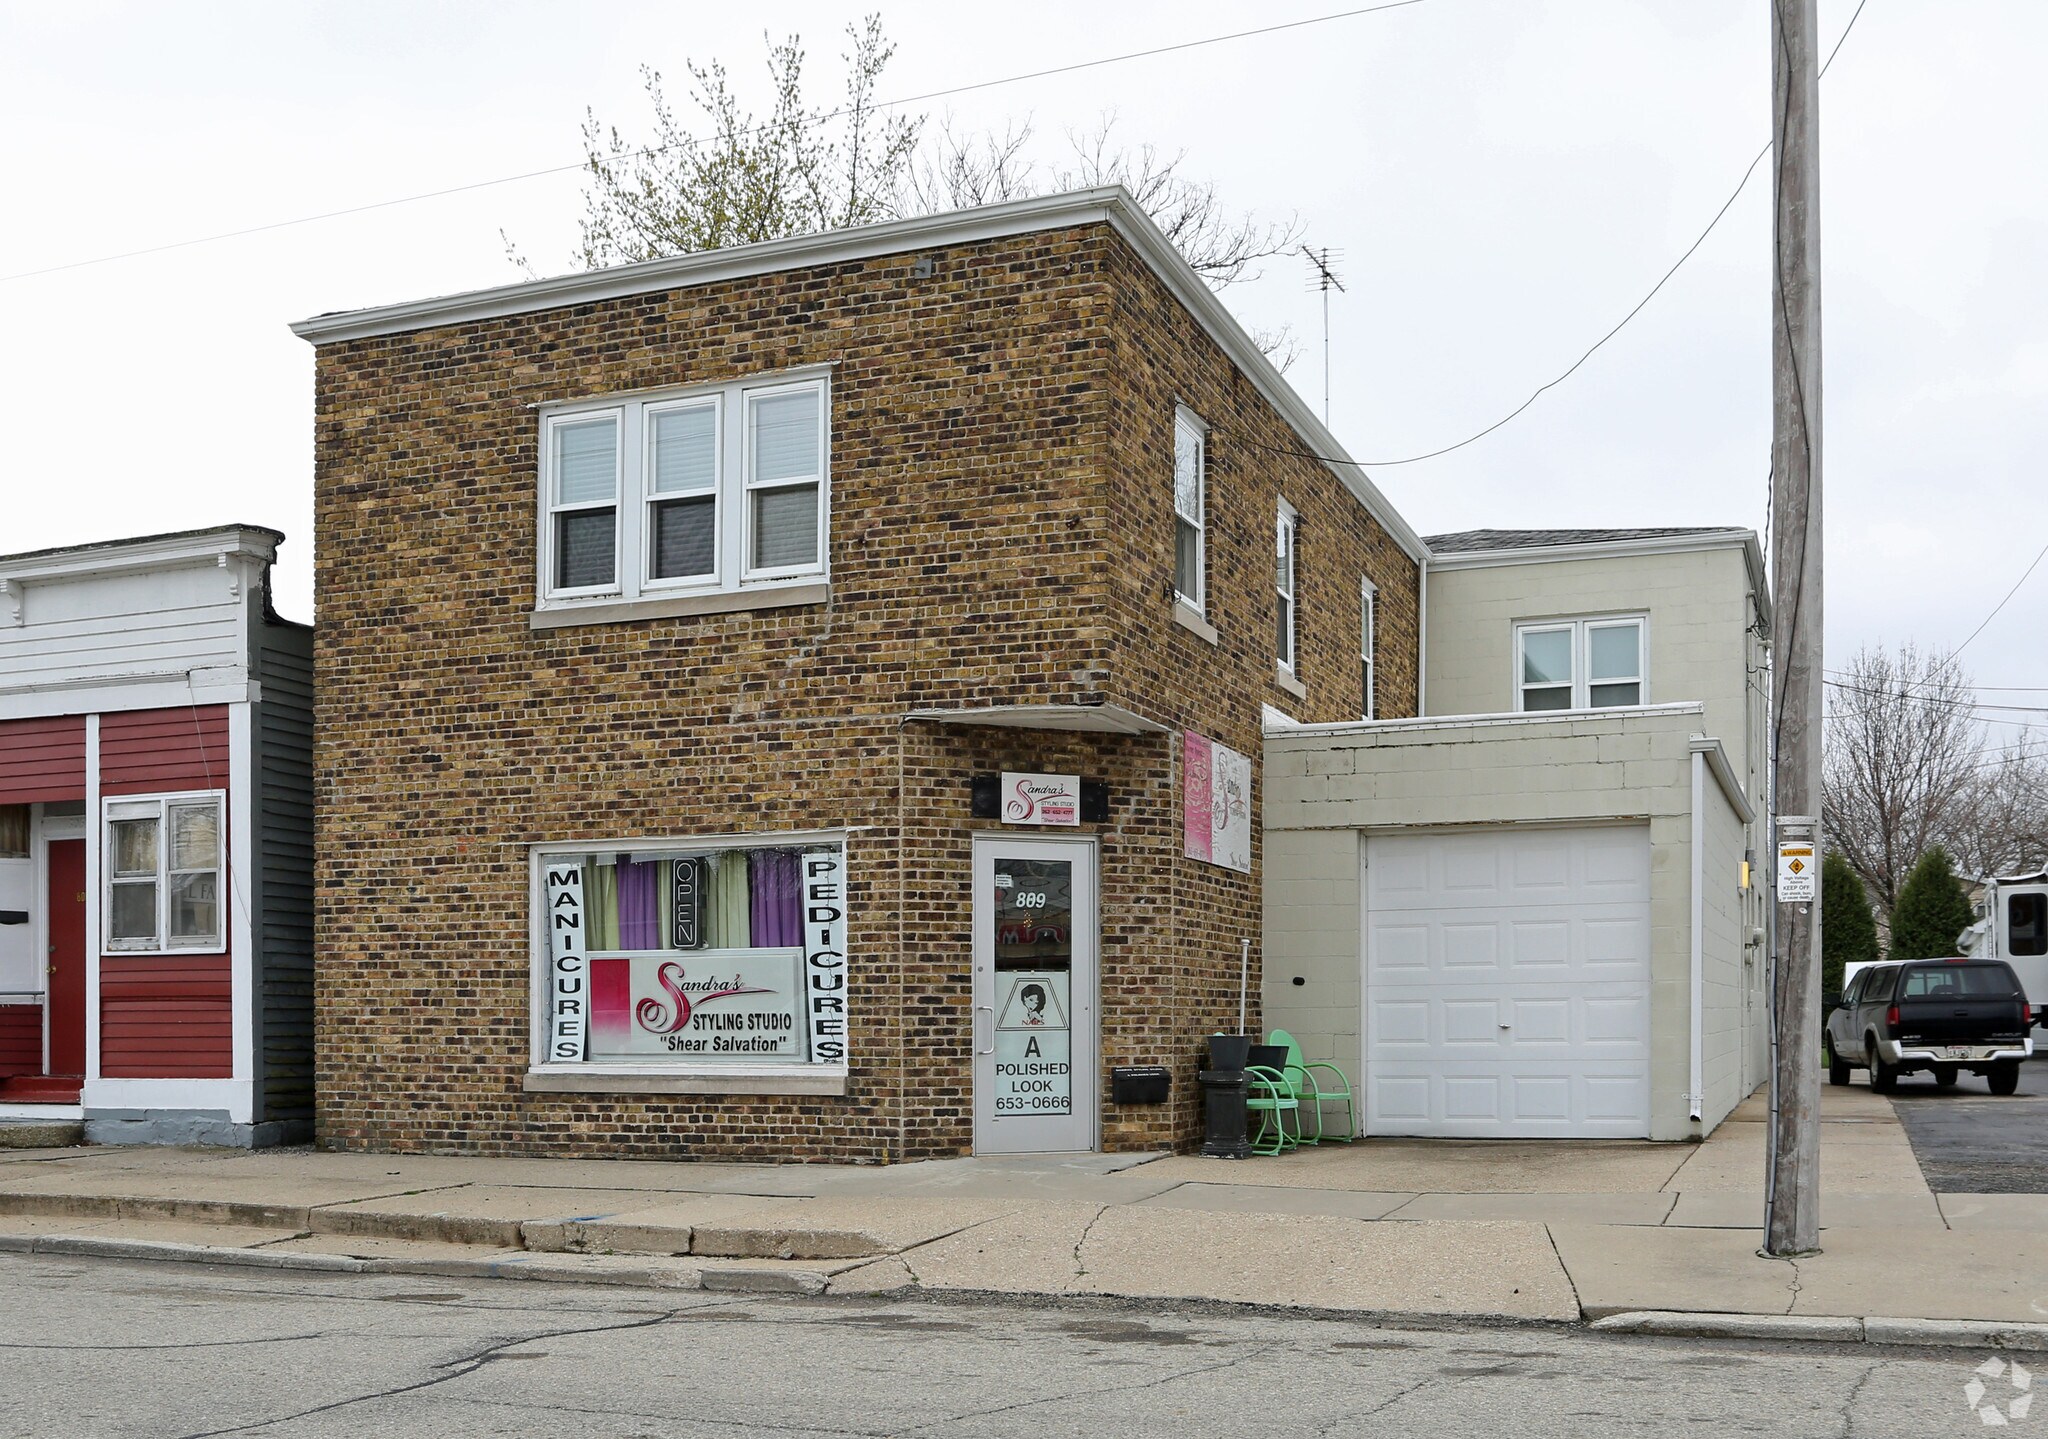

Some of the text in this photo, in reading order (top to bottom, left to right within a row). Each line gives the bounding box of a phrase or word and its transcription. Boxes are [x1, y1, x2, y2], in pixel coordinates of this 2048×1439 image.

[1007, 779, 1065, 822] Sandra's
[676, 862, 693, 943] OPEN
[549, 869, 582, 1058] MANICURES
[807, 861, 844, 1058] PEDICURES
[636, 961, 744, 1034] Sandra's
[693, 1013, 792, 1031] STYLING STUDIO
[659, 1035, 787, 1052] "Shear Salvation"
[1024, 1036, 1041, 1058] A
[996, 1063, 1069, 1076] POLISHED
[1011, 1080, 1053, 1092] LOOK
[996, 1096, 1070, 1110] 653-0666
